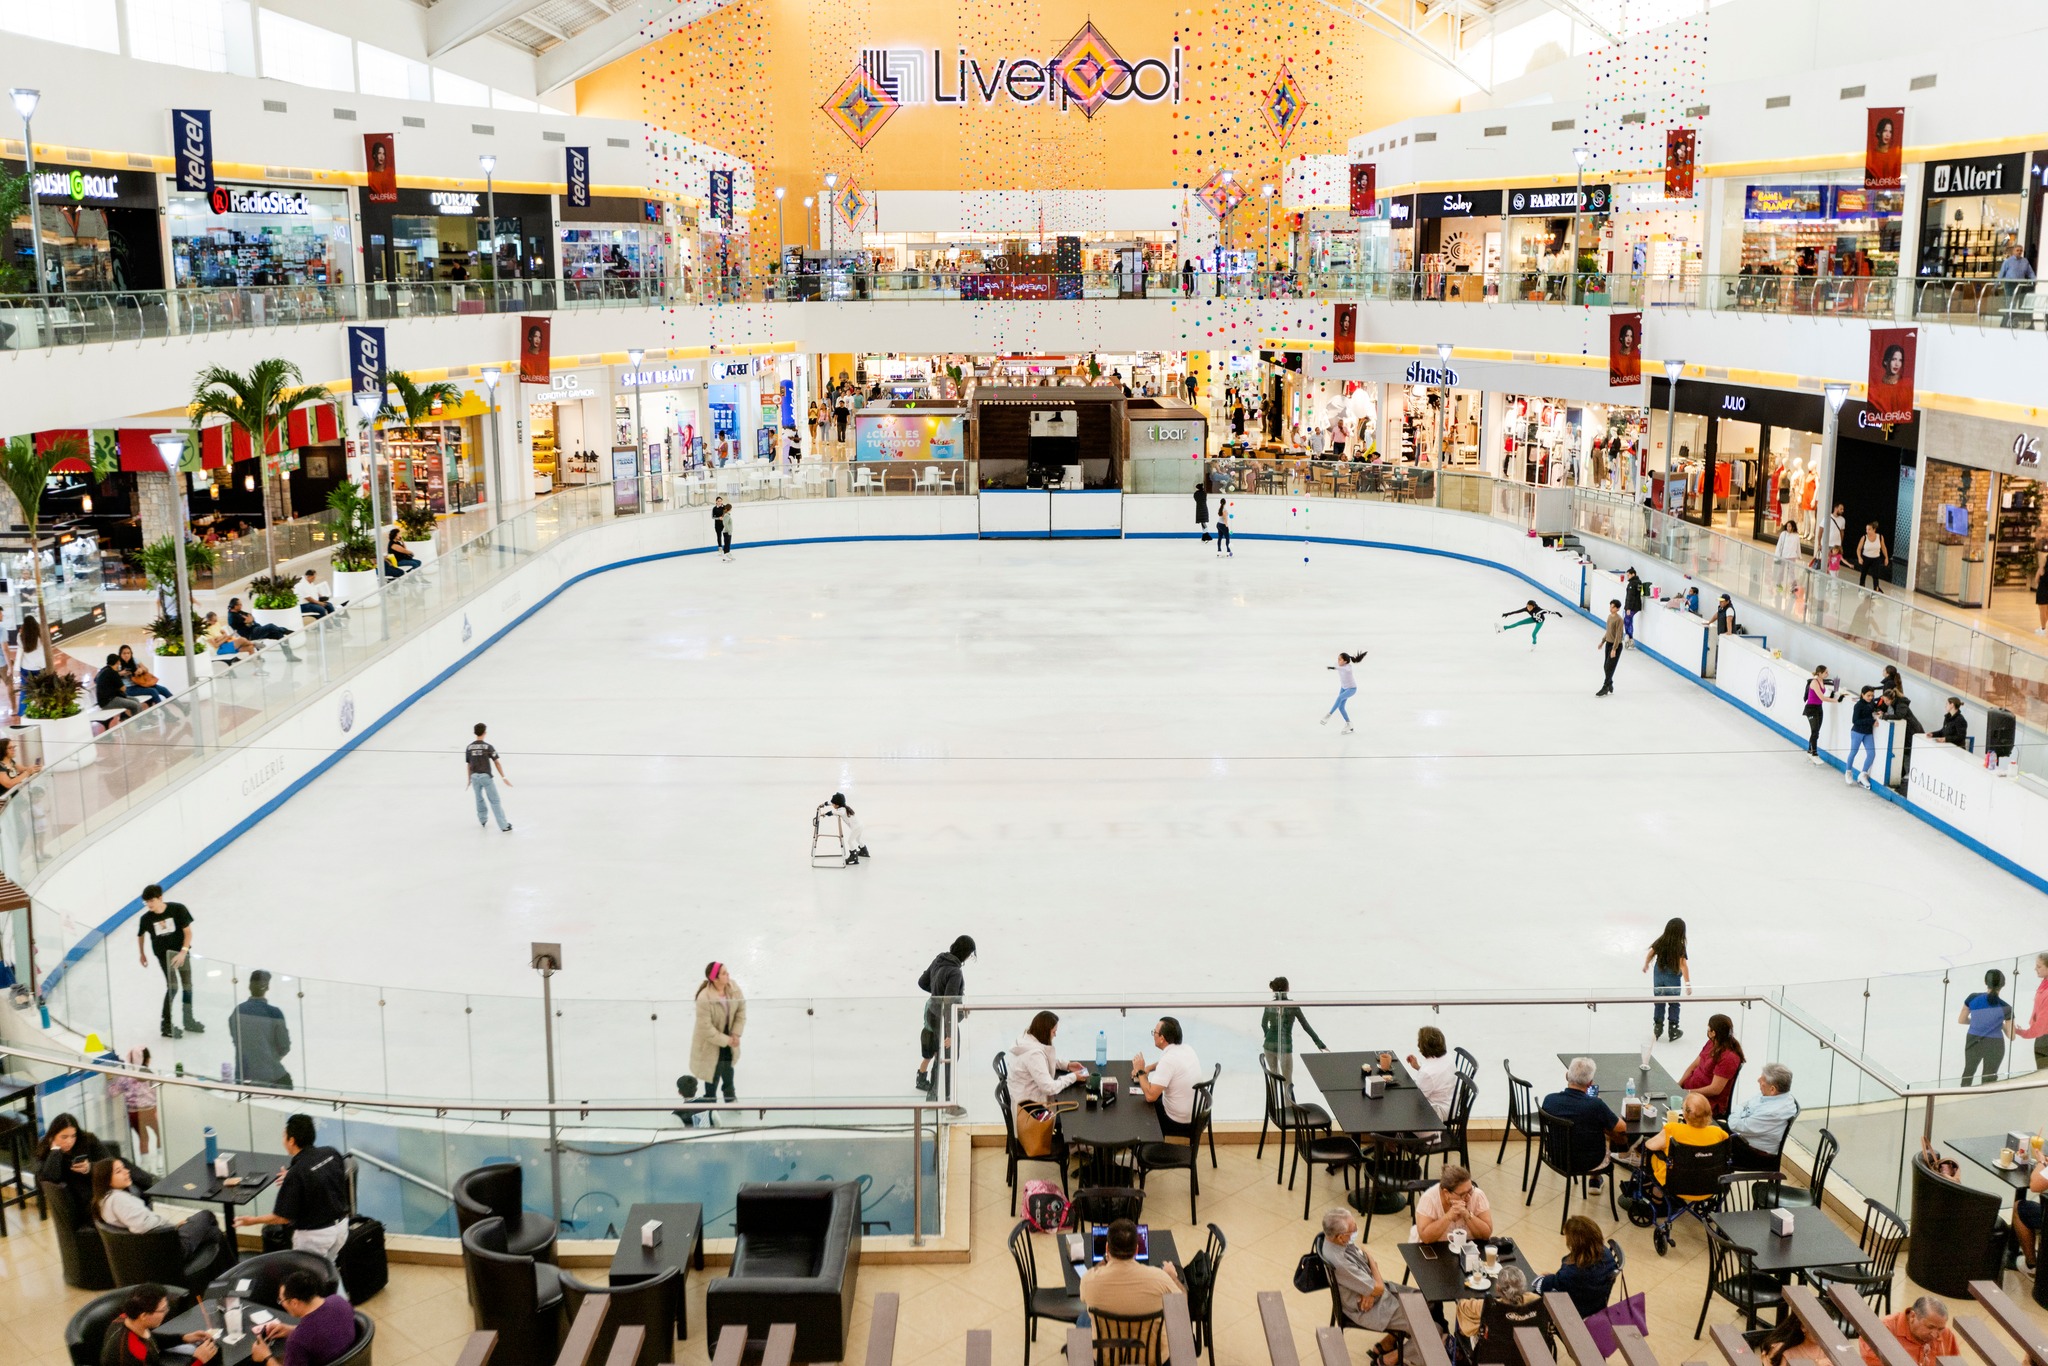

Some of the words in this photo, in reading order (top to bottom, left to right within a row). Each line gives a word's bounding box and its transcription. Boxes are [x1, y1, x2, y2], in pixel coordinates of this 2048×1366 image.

[935, 48, 1180, 111] Liverpool
[180, 112, 207, 190] telcel
[34, 172, 71, 195] SUSHI
[83, 174, 118, 198] ROLL
[570, 149, 586, 207] telcel
[1950, 163, 2003, 192] Alteri
[230, 190, 311, 215] RadioShack
[1443, 194, 1473, 213] Soley
[1530, 192, 1587, 208] FABRIZIO
[552, 374, 578, 391] DG
[623, 372, 653, 386] SALLY
[655, 369, 695, 384] BEAUTY
[726, 363, 748, 377] AT&T
[1406, 360, 1459, 386] shasa
[1722, 395, 1746, 411] JULIO
[866, 439, 881, 448] TU
[905, 430, 919, 439] ES
[241, 755, 286, 797] GALLERIE
[1910, 767, 1967, 811] GALLERIE
